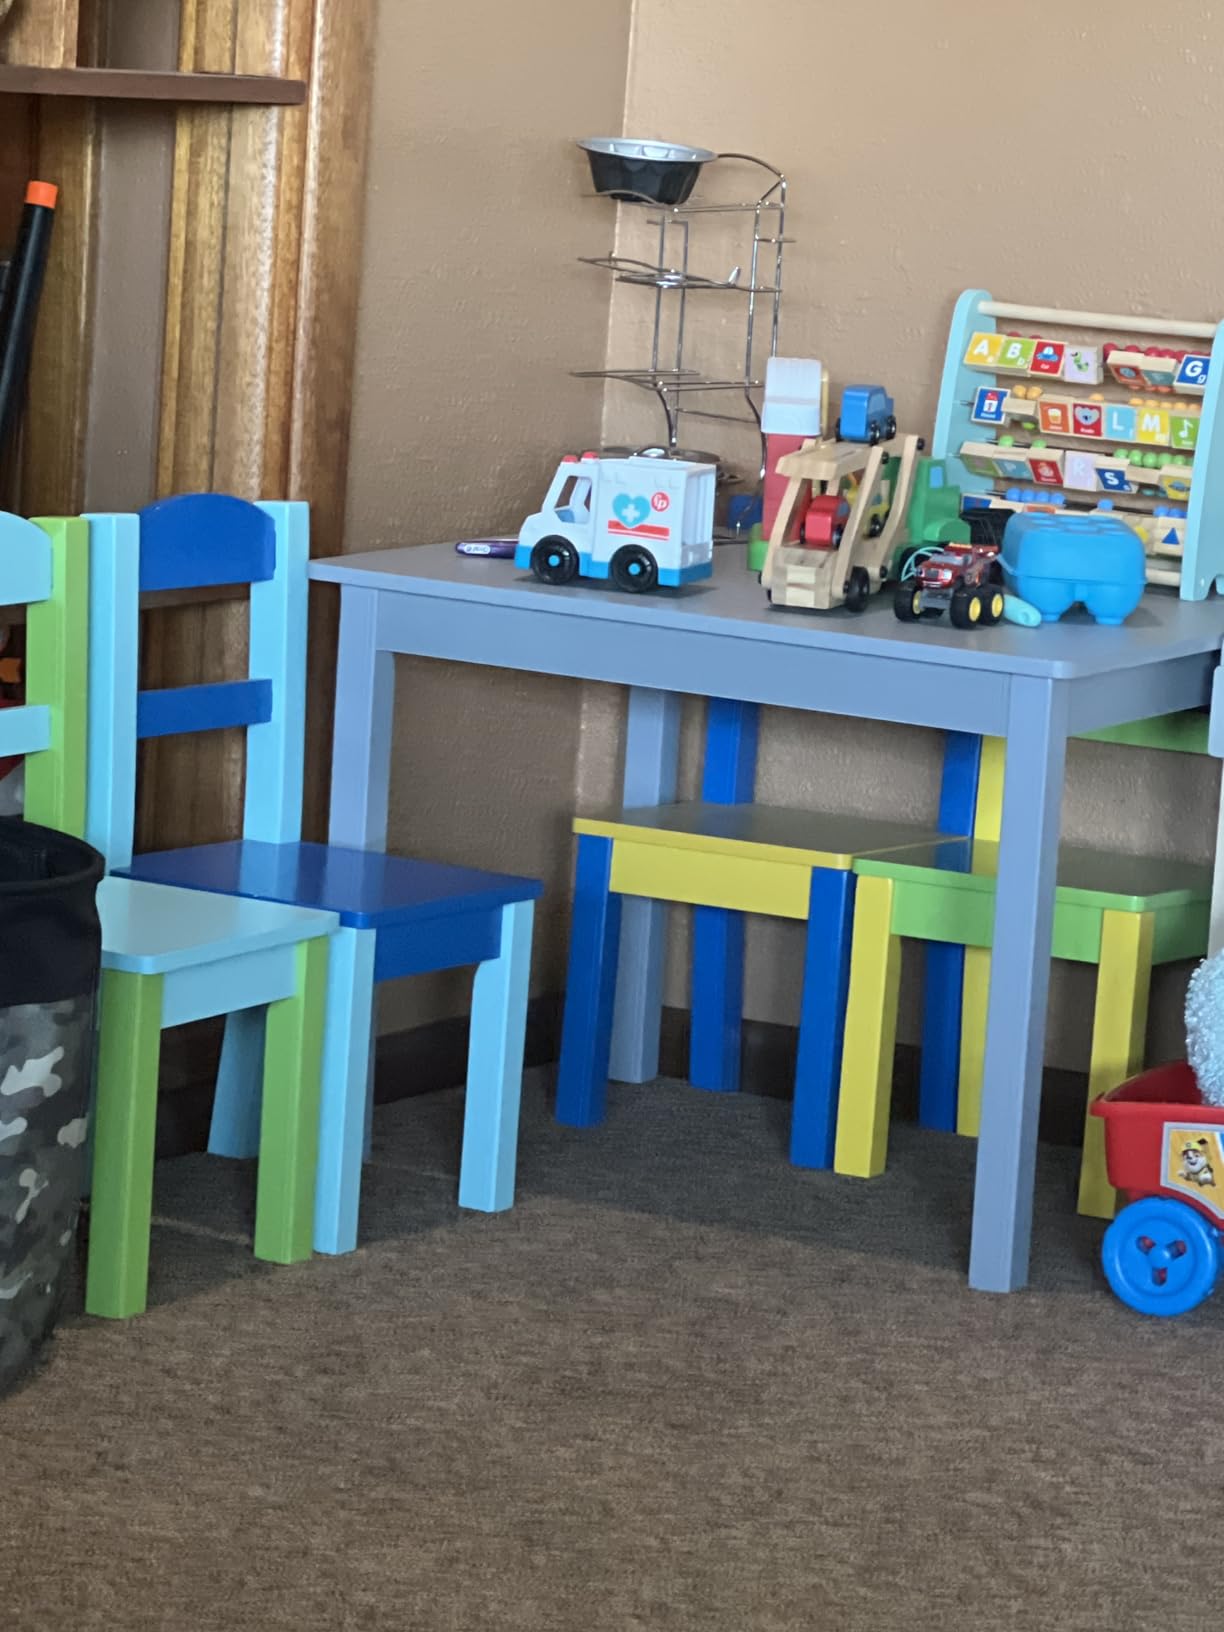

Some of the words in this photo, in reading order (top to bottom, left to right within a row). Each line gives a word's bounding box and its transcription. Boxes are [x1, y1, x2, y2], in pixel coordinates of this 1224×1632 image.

[974, 339, 989, 356] A
[1007, 342, 1022, 359] B
[1185, 360, 1203, 377] G
[1112, 411, 1124, 431] L
[1142, 413, 1160, 432] M
[1104, 472, 1119, 485] S
